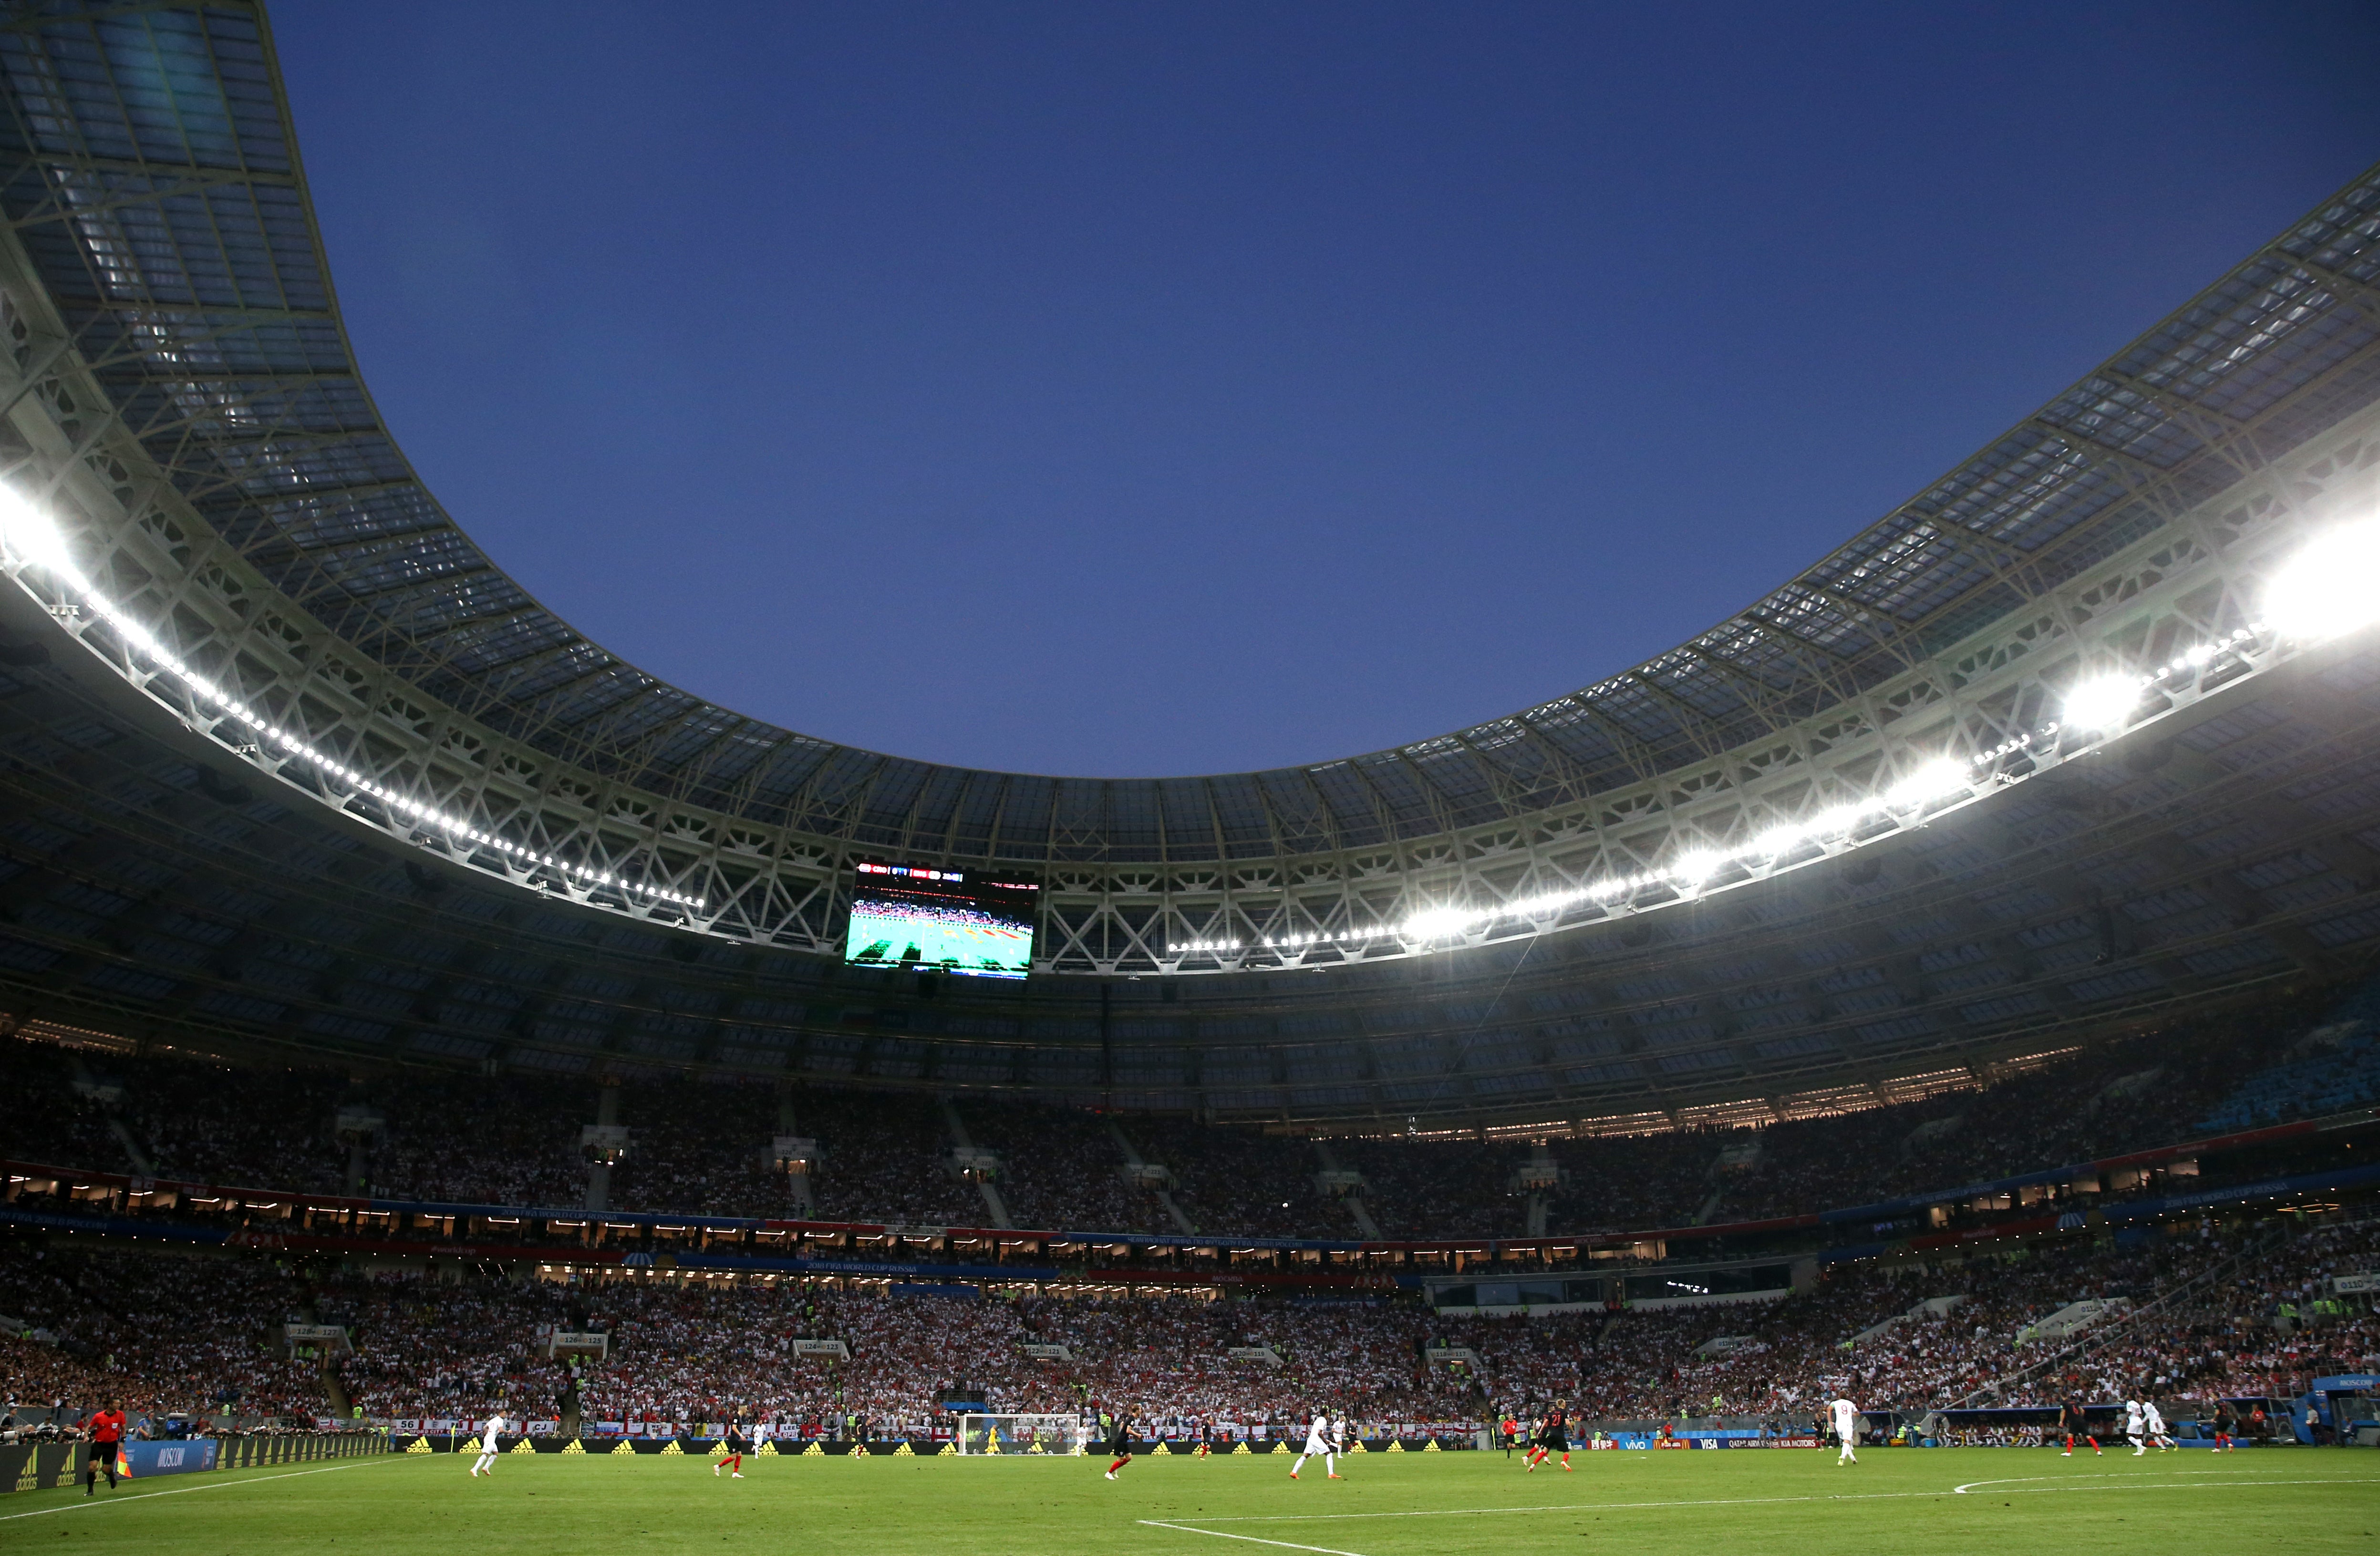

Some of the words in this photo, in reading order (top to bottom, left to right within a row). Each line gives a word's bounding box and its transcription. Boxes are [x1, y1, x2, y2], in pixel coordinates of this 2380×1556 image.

[1841, 1405, 1848, 1415] 9
[1552, 1414, 1561, 1427] 21
[1699, 1438, 1718, 1449] VISA
[157, 1447, 186, 1468] MOSCOW
[16, 1474, 38, 1492] adidas
[57, 1470, 76, 1487] adidas
